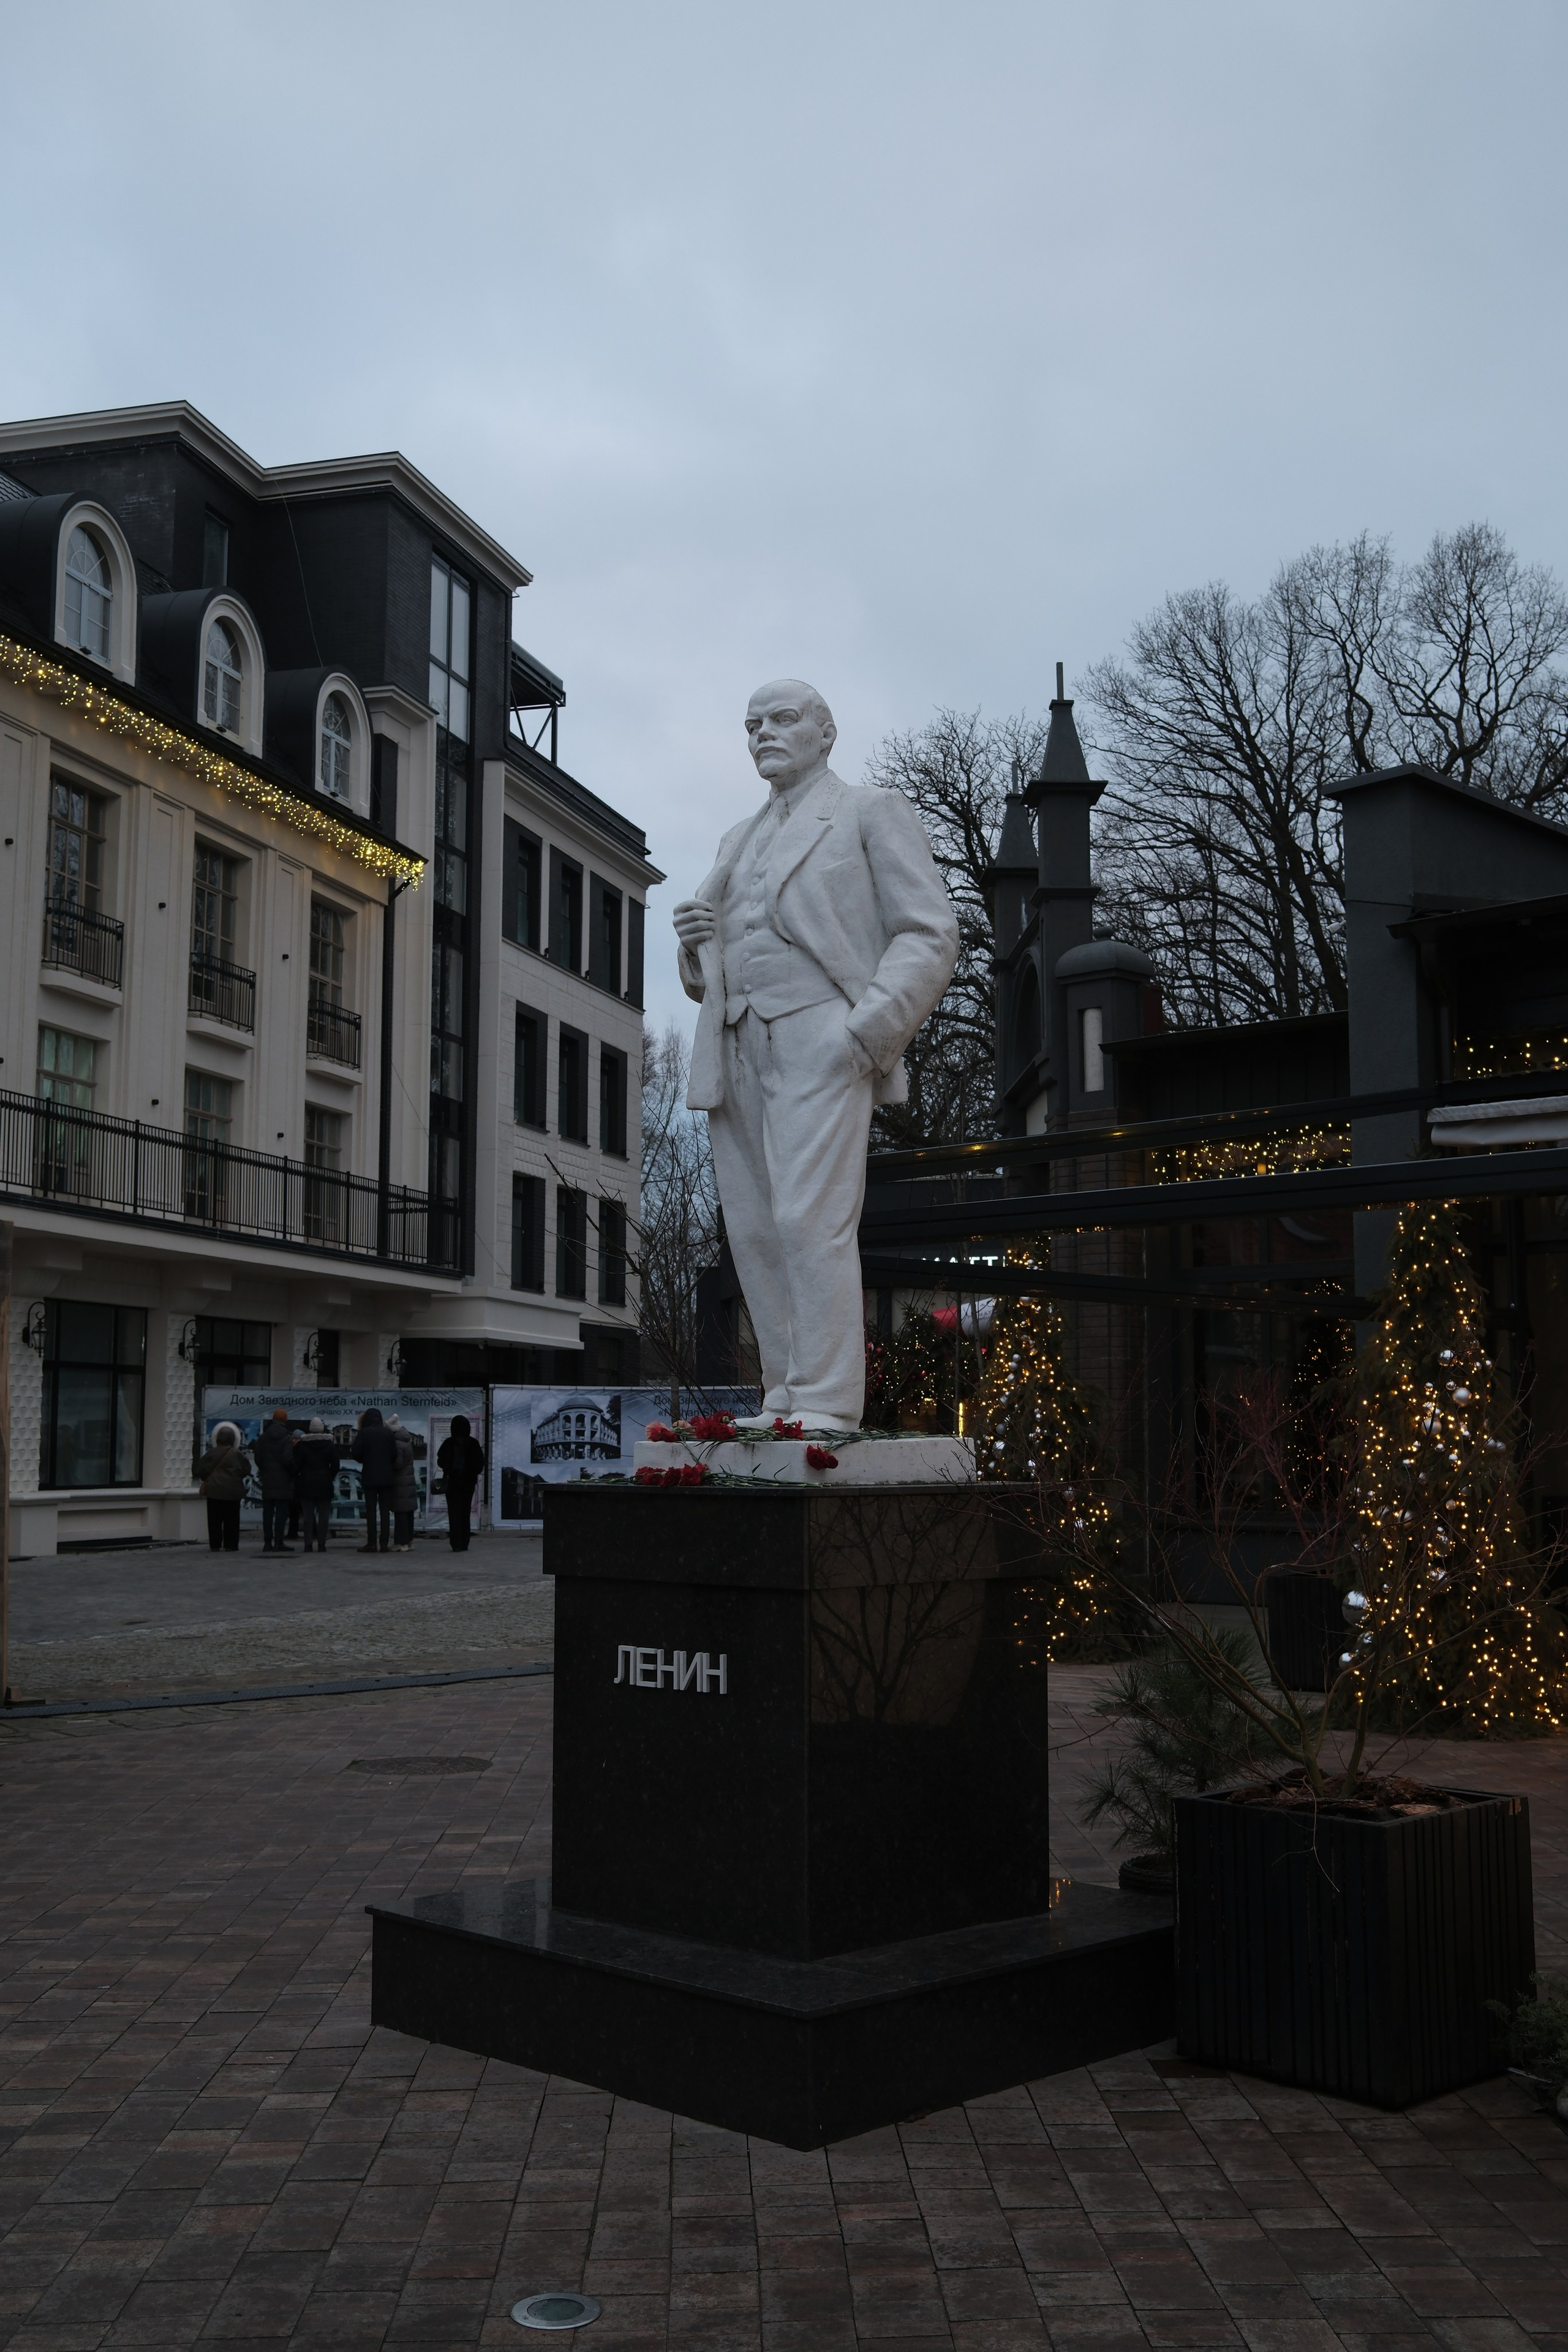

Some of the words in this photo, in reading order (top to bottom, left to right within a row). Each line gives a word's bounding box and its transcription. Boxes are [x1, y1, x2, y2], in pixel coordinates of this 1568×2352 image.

[230, 1395, 254, 1406] Дом
[258, 1395, 316, 1406] Звездного
[320, 1396, 347, 1406] неба
[351, 1396, 397, 1406] «Nathan
[401, 1396, 457, 1406] Sternfeld»
[614, 1645, 727, 1694] ЛЕНИН
